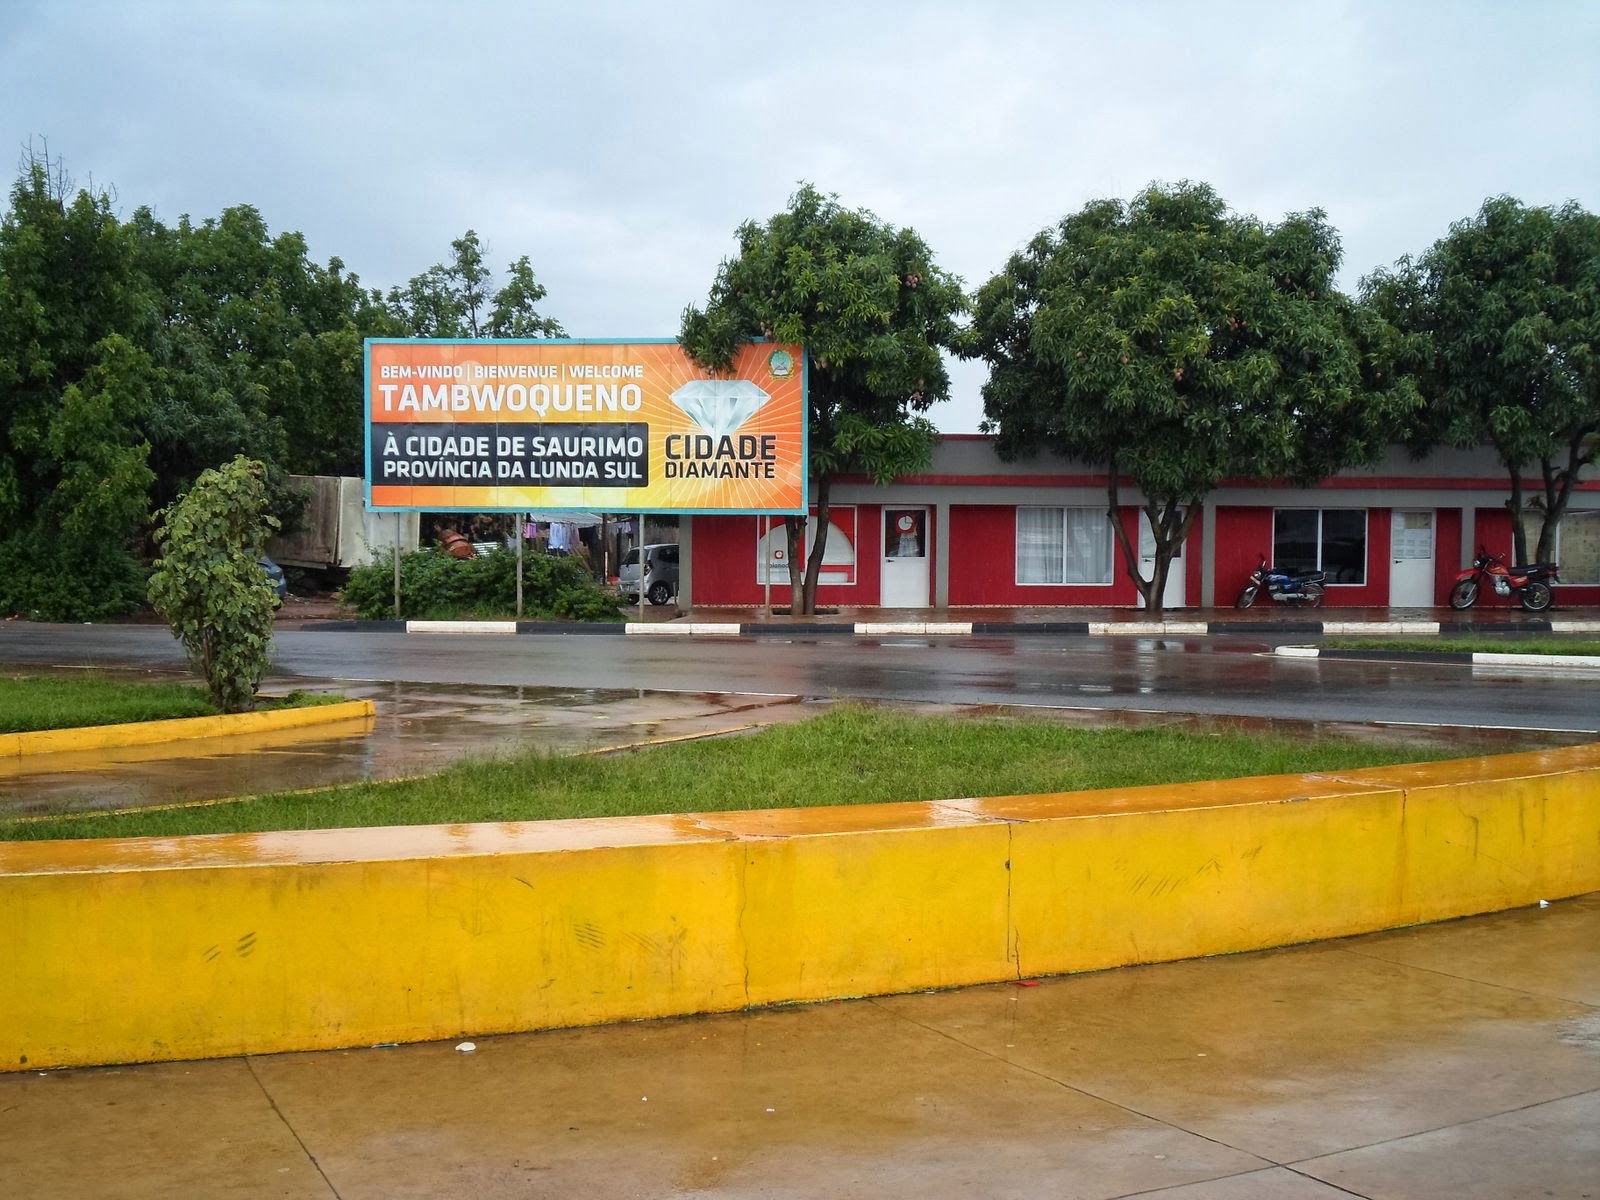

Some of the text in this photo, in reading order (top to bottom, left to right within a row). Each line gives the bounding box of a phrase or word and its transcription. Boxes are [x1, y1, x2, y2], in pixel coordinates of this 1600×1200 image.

[381, 365, 643, 379] BEM-VINDO BIENVENUE WELCOME
[378, 383, 642, 417] TAMBWOQUENO
[383, 432, 643, 457] À CIDADE DE SAURIMO
[665, 434, 777, 460] CIDADE
[383, 457, 643, 479] PROVÍNCIA DA LUNDA SUL
[665, 461, 775, 479] DIAMANTE
